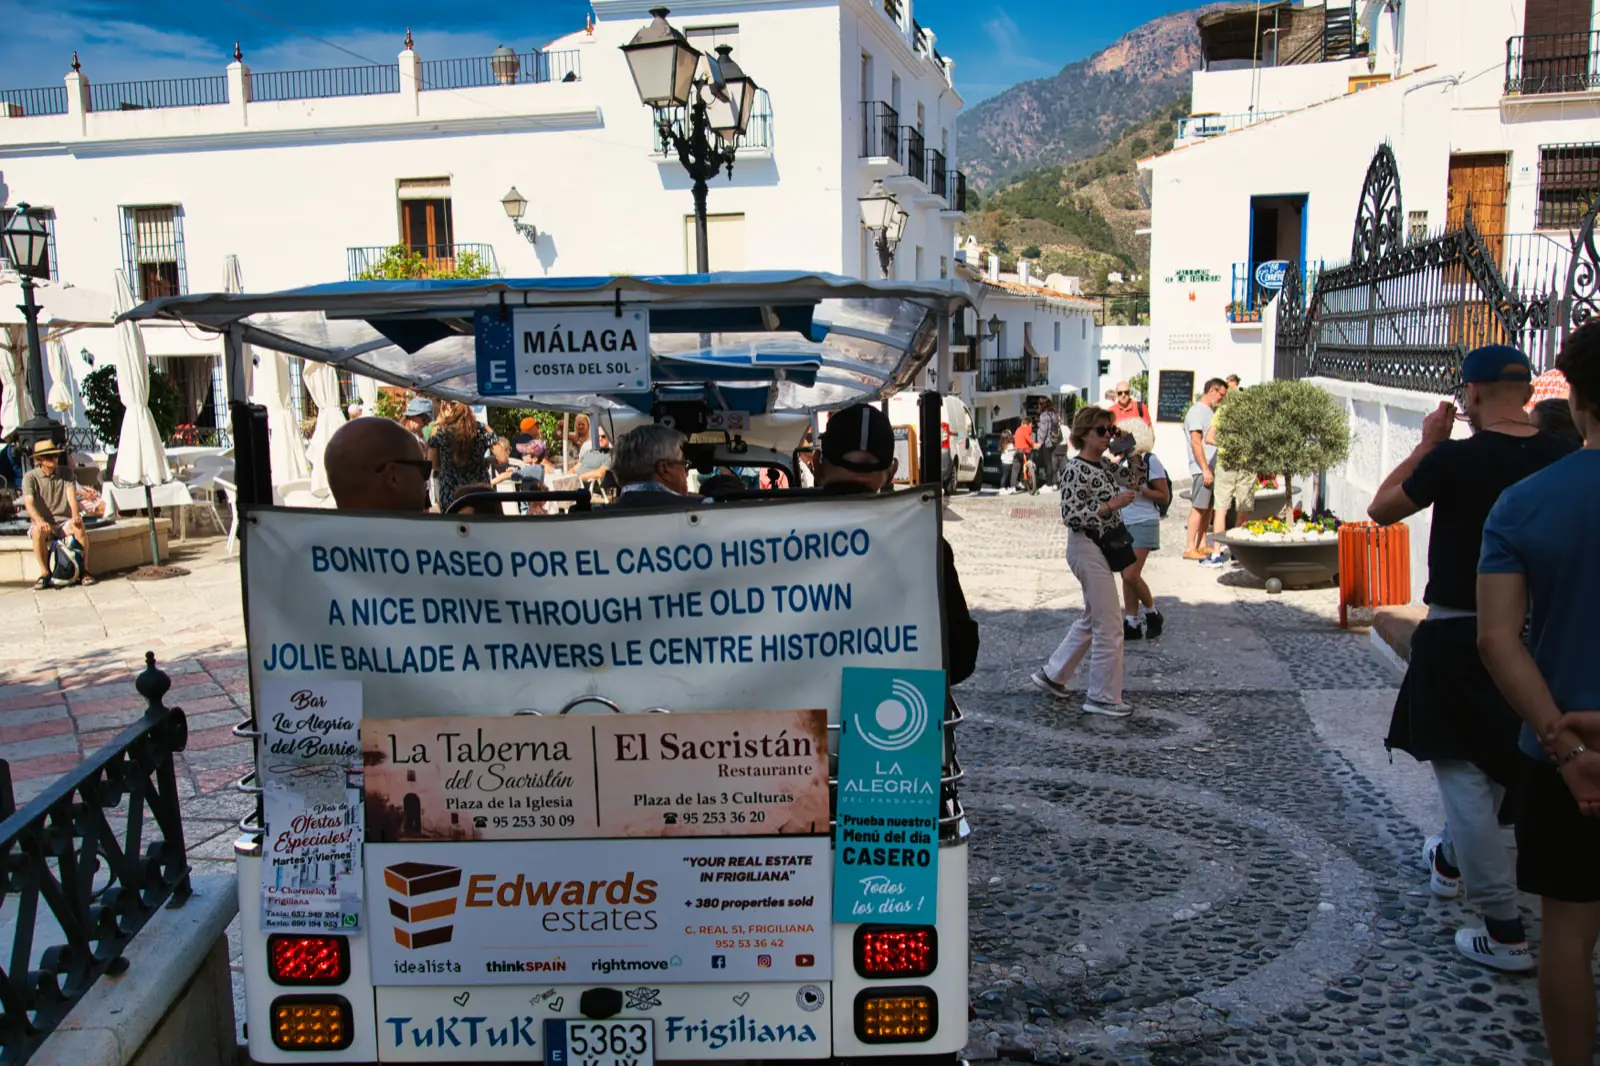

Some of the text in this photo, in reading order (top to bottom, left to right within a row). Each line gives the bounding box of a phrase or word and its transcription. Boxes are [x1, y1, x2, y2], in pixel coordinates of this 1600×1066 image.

[523, 323, 638, 354] MÁLAGA
[489, 360, 508, 384] E
[533, 361, 631, 376] COSTA DEL SOL
[312, 528, 870, 578] BONITO PASEO POR EL CASCO HISTÓRICO
[329, 582, 852, 626] A NICE DRIVE THROUGH THE OLD TOWN
[263, 624, 919, 674] JOLIE BALLADE A TRAVERS LE CENTRE HISTORIQUE
[290, 689, 328, 710] Bar
[272, 712, 354, 736] La Alegría
[270, 735, 358, 758] del Barrio
[388, 727, 573, 764] La Taberna
[614, 729, 813, 762] El Sacristán
[718, 763, 813, 778] Restaurante
[875, 761, 903, 776] LA
[445, 763, 575, 792] del Sacristán
[844, 778, 934, 795] ALEGRÍA
[446, 796, 573, 813] Plaza de la Iglesia
[633, 791, 794, 807] Plaza de las 3 Culturas
[290, 814, 342, 834] Ofertas
[492, 814, 575, 829] 95 253 30 09
[683, 811, 766, 825] 95 253 36 20
[844, 814, 932, 828] Prueba nuestro
[273, 827, 353, 855] Especiales!
[843, 828, 880, 843] Menú
[884, 830, 906, 844] del
[272, 851, 352, 867] Martes y Viernes
[728, 856, 763, 867] REAL
[765, 855, 813, 867] ESTATE
[842, 846, 931, 868] CASERO
[700, 871, 715, 883] IN
[859, 875, 906, 896] Todos
[465, 871, 659, 909] Edwards
[268, 896, 310, 906] Frigiliana
[695, 898, 719, 908] 380
[721, 896, 785, 911] properties
[787, 896, 814, 907] sold
[852, 899, 875, 915] los
[878, 897, 914, 914] días
[266, 919, 290, 927] Kevin:
[541, 908, 658, 932] estates
[699, 925, 728, 935] REAL
[748, 923, 814, 934] FRIGILIANA
[715, 938, 785, 949] 952 53 36 42
[394, 958, 462, 974] idealista
[486, 957, 567, 973] thinkSPAIN
[591, 957, 668, 975] rightmove
[570, 1024, 647, 1055] 5363
[665, 1014, 817, 1050] Frigiliana
[552, 1050, 562, 1061] E
